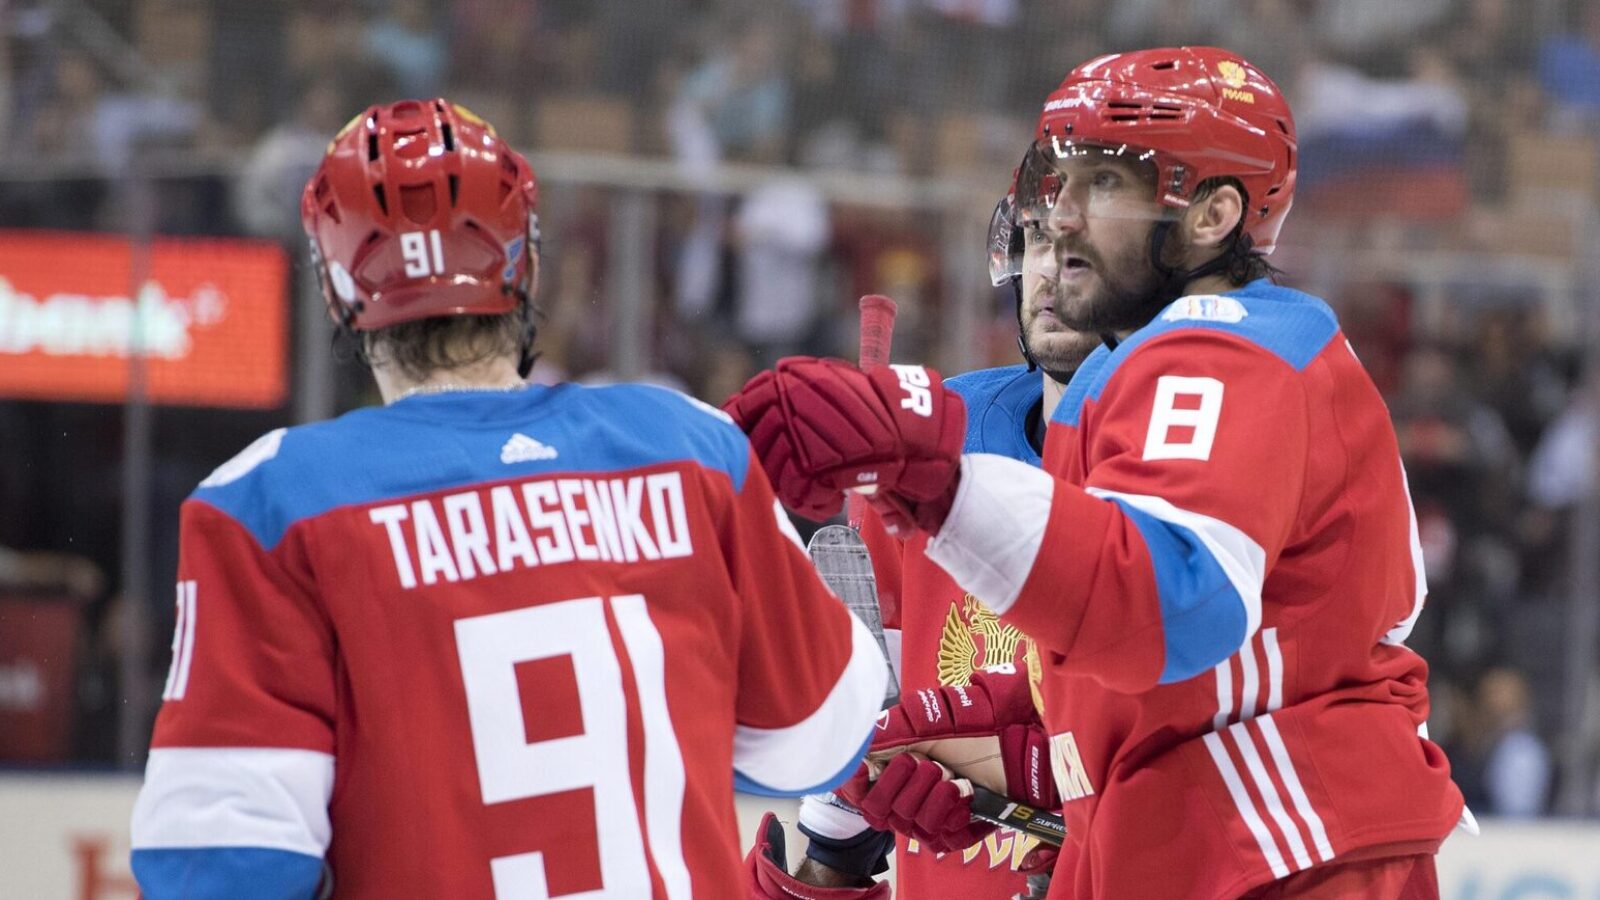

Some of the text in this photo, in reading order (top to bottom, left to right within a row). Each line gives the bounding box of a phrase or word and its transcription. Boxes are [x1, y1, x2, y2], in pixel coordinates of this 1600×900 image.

[401, 229, 445, 278] 91
[1142, 375, 1225, 461] 8
[368, 471, 693, 589] TARASENKO
[453, 593, 693, 900] 91
